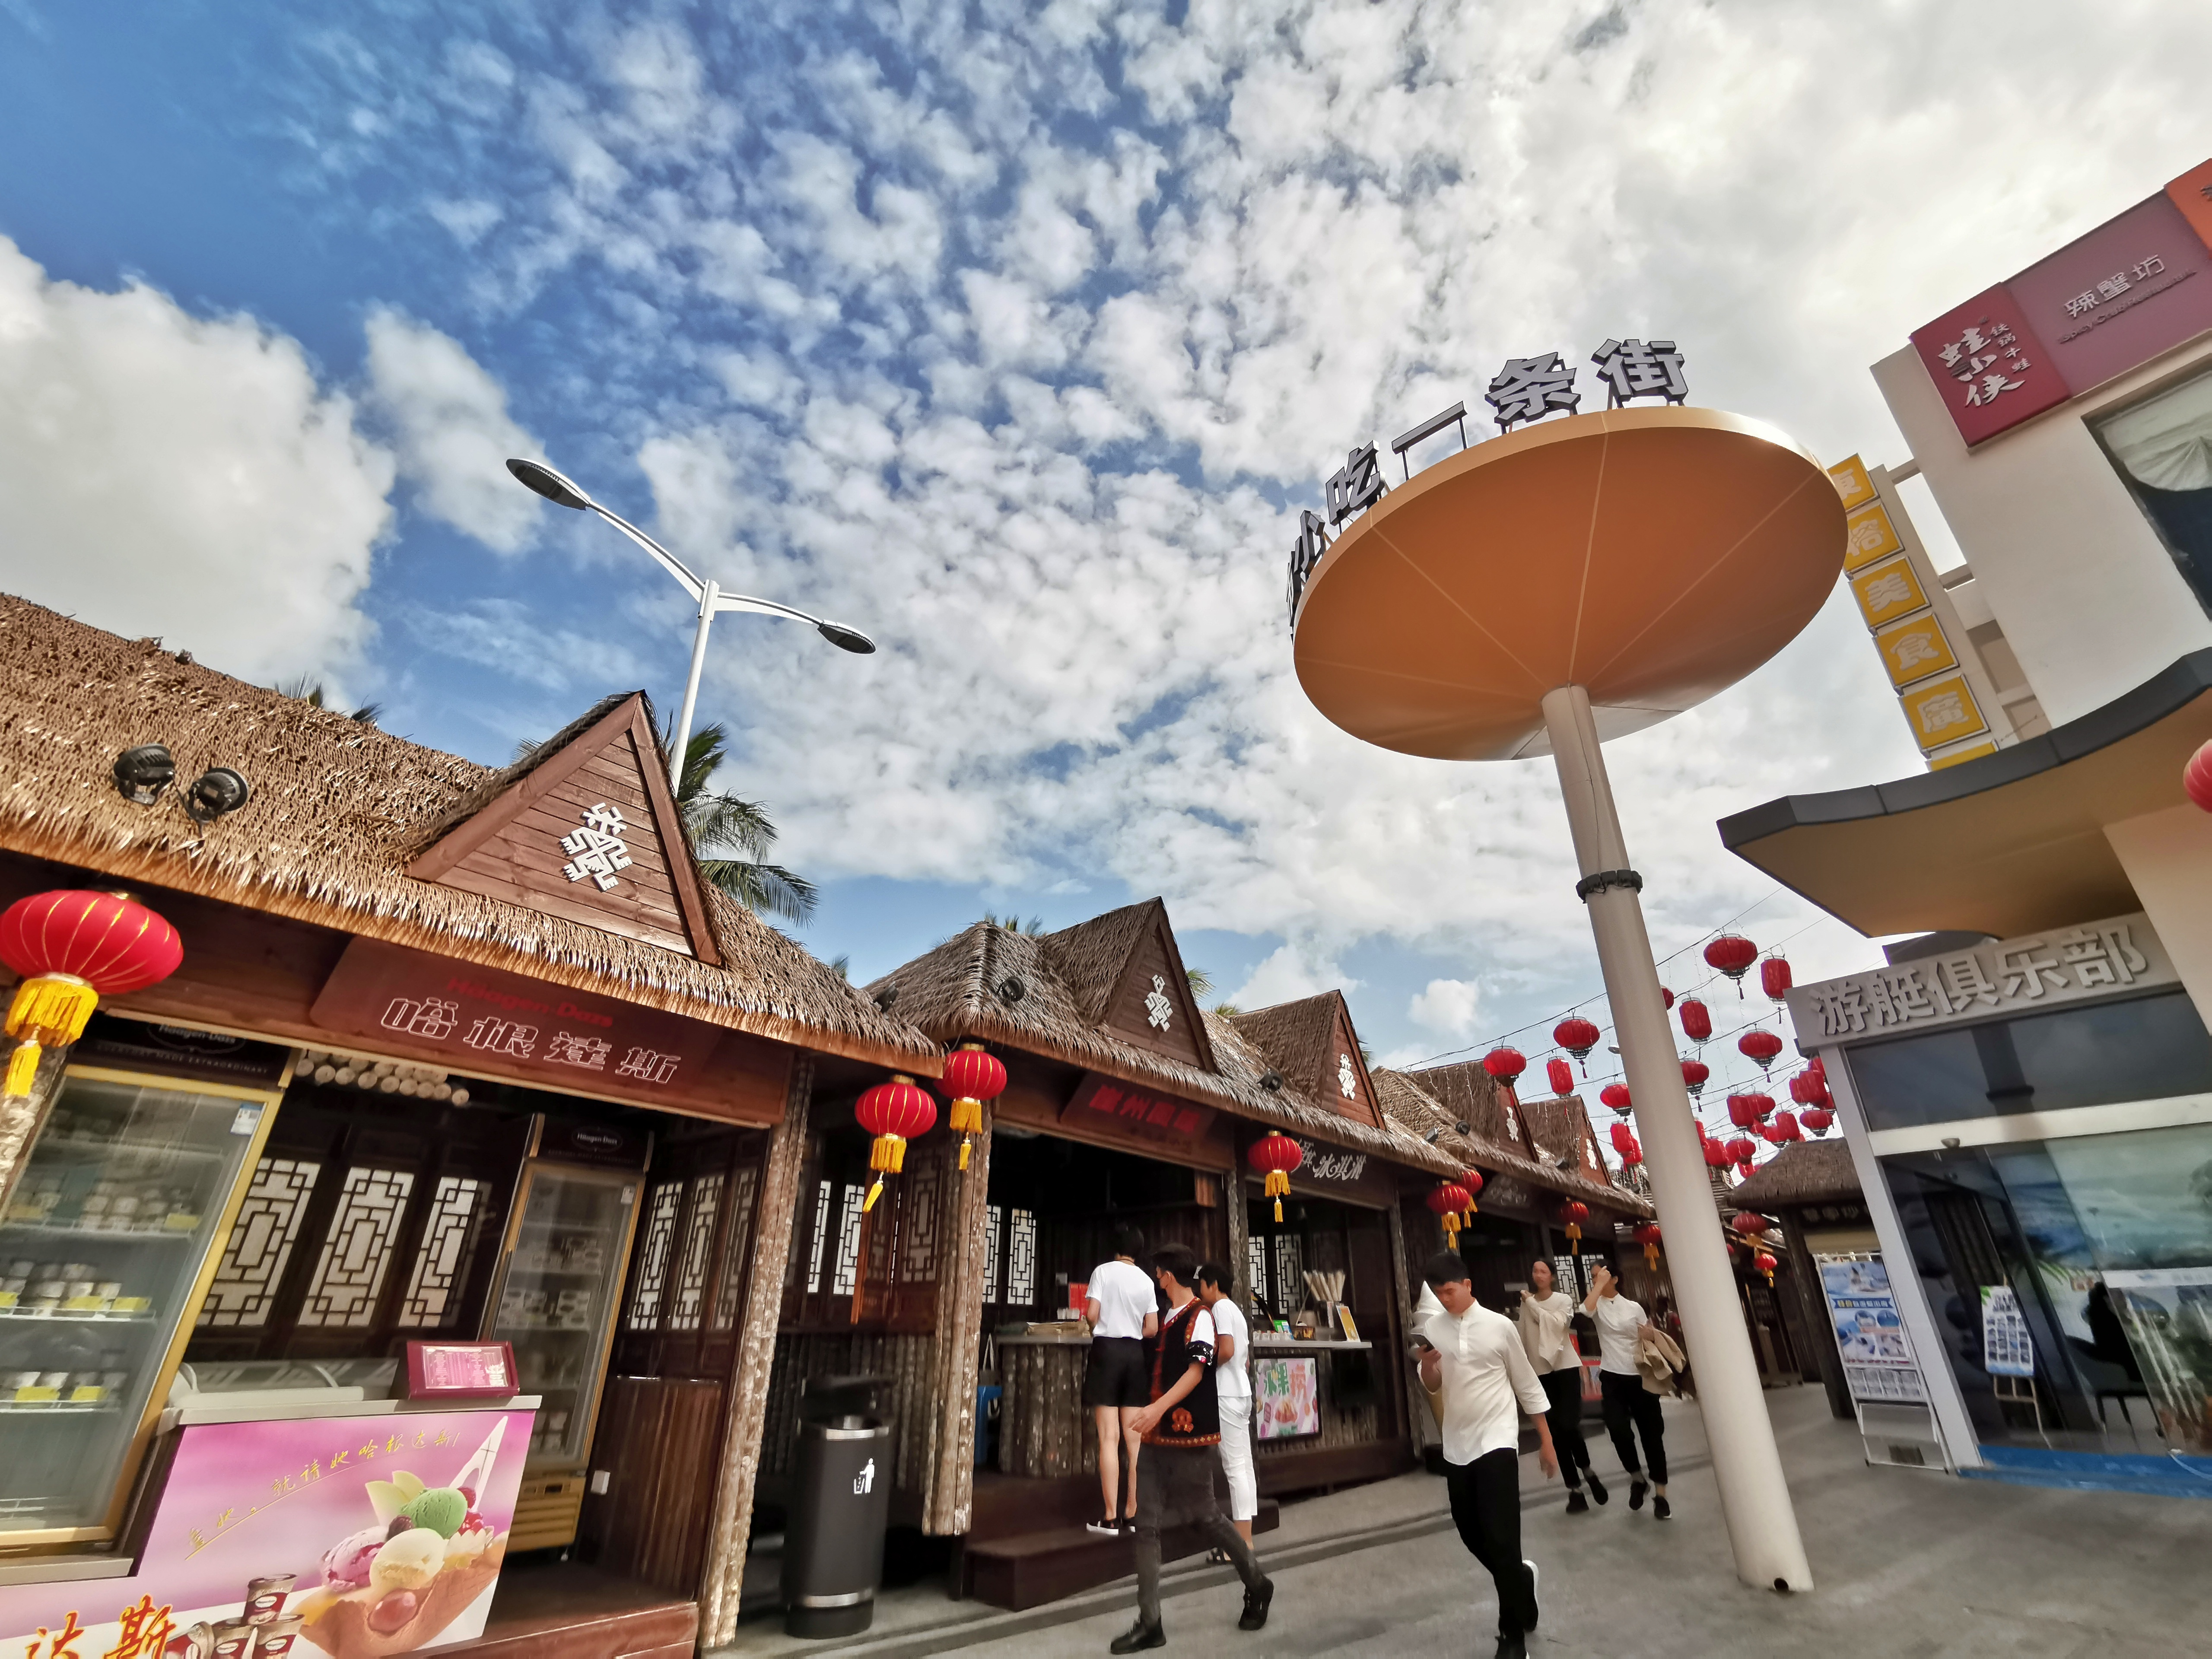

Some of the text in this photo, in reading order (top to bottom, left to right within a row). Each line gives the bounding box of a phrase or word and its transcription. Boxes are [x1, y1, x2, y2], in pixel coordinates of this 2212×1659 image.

[2063, 254, 2165, 318] 辣蟹坊
[1990, 323, 2031, 373] 铁锅牛蛙
[1809, 924, 2149, 1036] 游艇俱乐部
